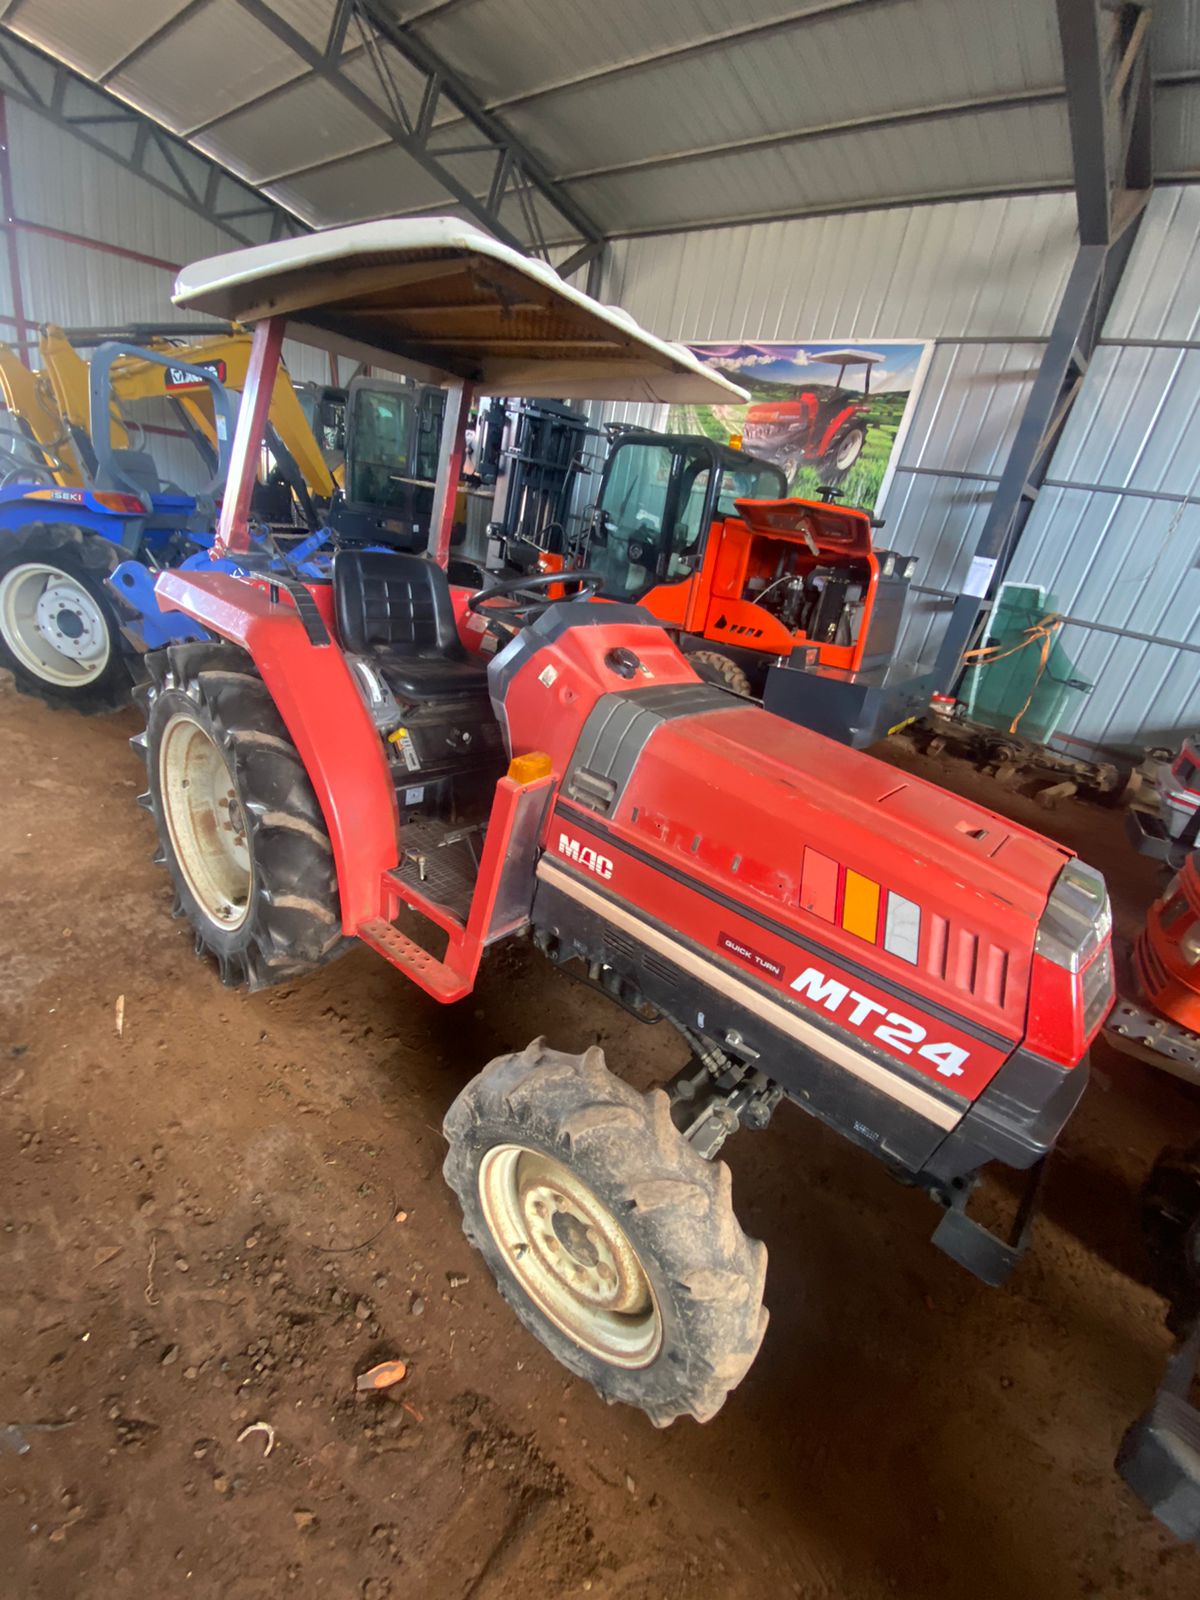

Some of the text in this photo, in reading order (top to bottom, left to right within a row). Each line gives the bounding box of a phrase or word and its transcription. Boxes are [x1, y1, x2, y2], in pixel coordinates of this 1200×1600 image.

[51, 491, 82, 502] ISEKI
[558, 833, 614, 880] MAC
[725, 939, 781, 975] QUICK TURN
[789, 966, 972, 1078] MT24
